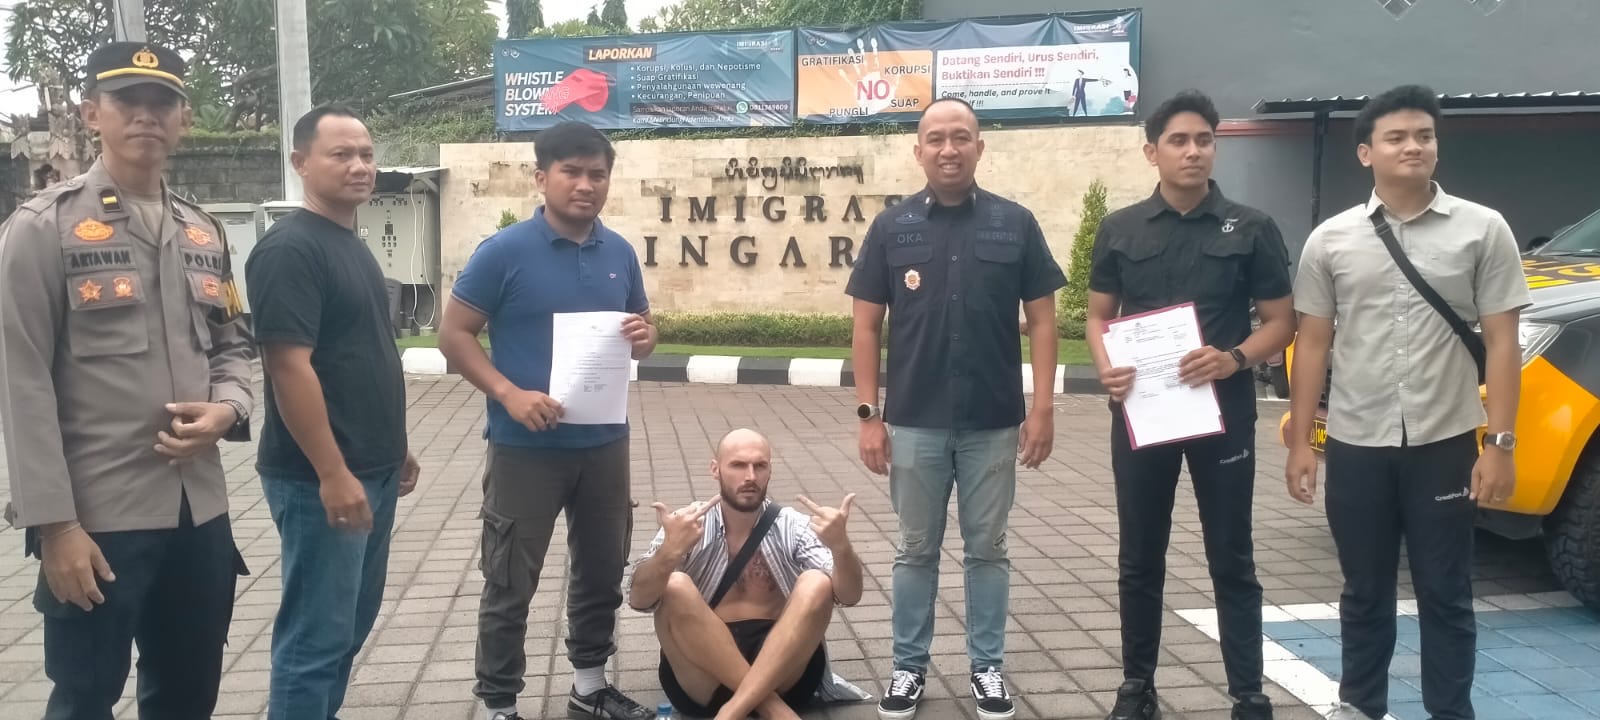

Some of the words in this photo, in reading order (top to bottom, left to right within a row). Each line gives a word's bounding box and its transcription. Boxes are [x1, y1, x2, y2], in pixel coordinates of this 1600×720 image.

[588, 47, 653, 61] LAPORKAN
[801, 55, 864, 66] GRATIFIKASI
[942, 56, 981, 67] Datang
[984, 52, 1025, 64] Sendiri,
[1027, 51, 1054, 62] Urus
[699, 63, 714, 71] dan
[717, 63, 761, 72] Nepotisme
[884, 65, 931, 75] KORUPSI
[941, 70, 991, 80] Buktikan
[993, 67, 1032, 78] Sendiri
[1034, 67, 1045, 77] !!!
[505, 71, 564, 86] WHISTLE
[636, 73, 656, 82] Suap
[657, 72, 699, 81] Gratifikasi
[687, 91, 726, 100] Penipuan
[857, 79, 890, 100] NO
[941, 90, 967, 98] Come,
[968, 88, 999, 97] handle,
[1000, 88, 1017, 96] and
[1018, 87, 1044, 97] prove
[890, 98, 920, 108] SUAP
[829, 107, 868, 117] PUNGLI
[896, 232, 924, 245] OKA
[643, 235, 858, 268] INGAR
[70, 251, 132, 269] ARTAWAN
[184, 252, 222, 270] POLRI
